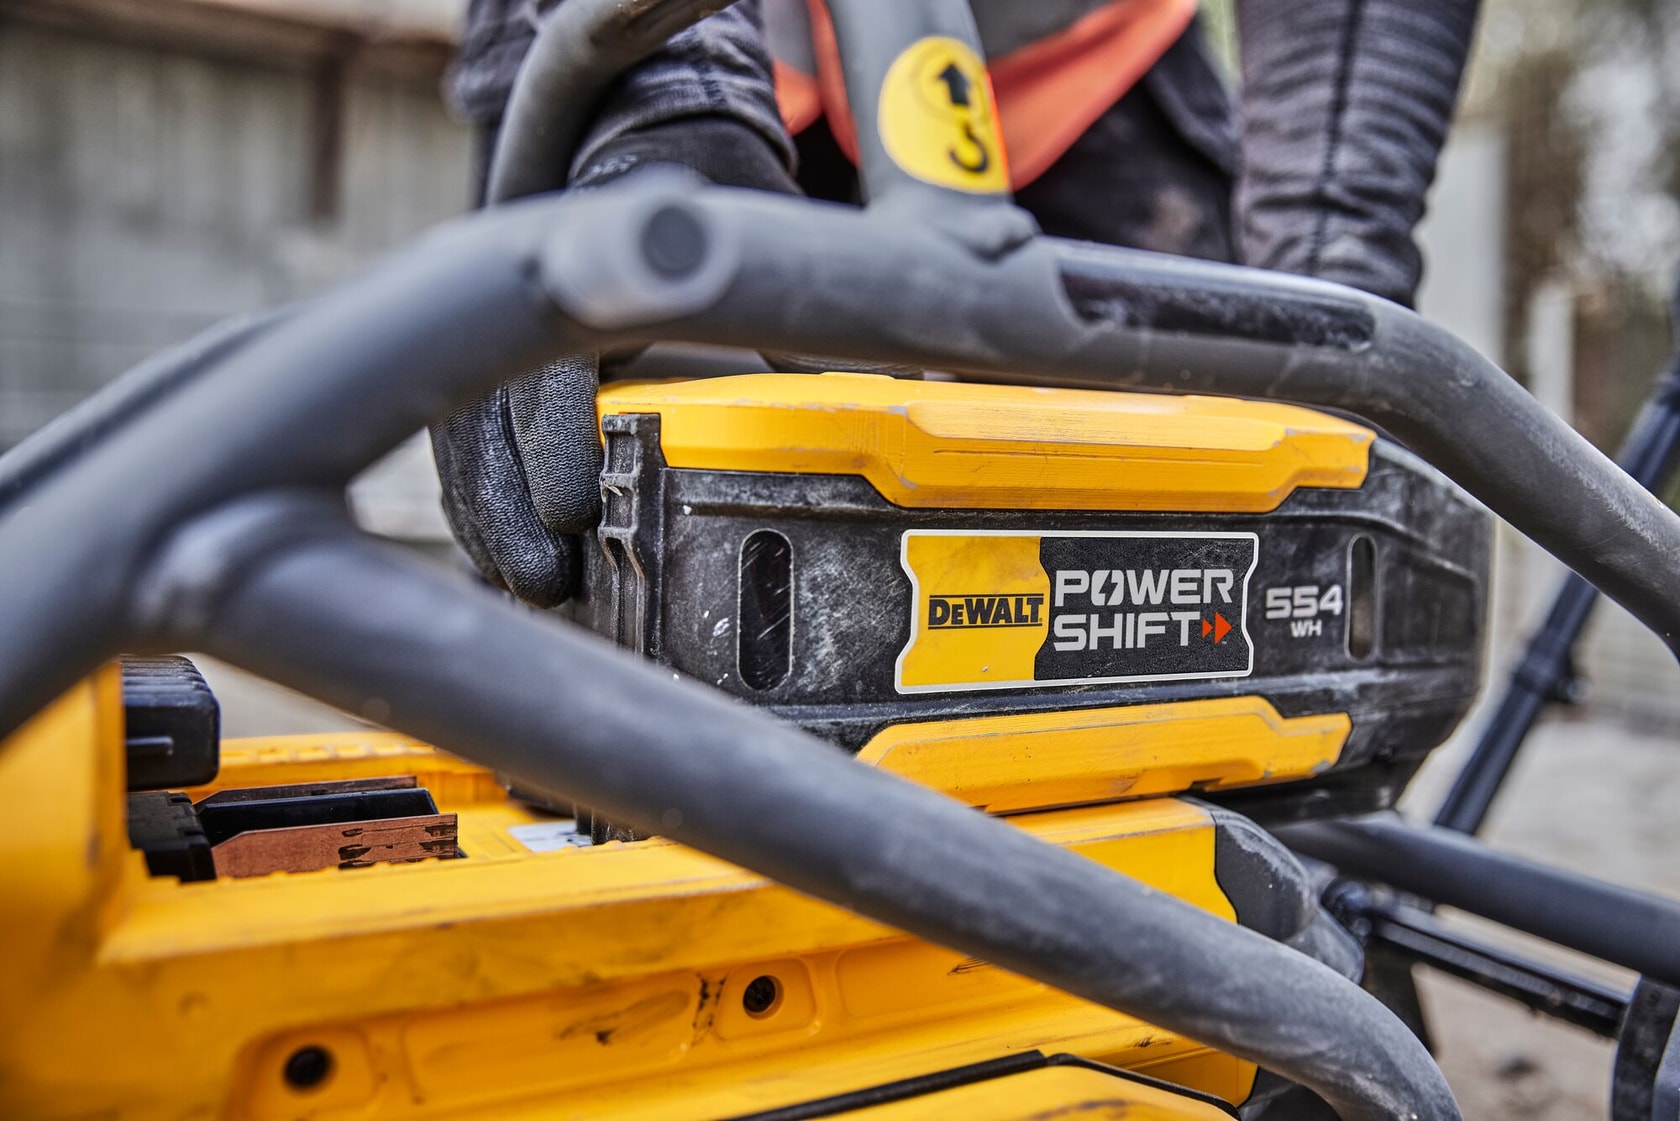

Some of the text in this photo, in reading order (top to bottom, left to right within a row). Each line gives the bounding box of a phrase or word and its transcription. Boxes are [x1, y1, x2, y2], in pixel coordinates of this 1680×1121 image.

[1054, 569, 1232, 607] POWER
[1265, 586, 1343, 620] 554
[1054, 611, 1200, 652] SHIFT
[1291, 621, 1322, 638] WH
